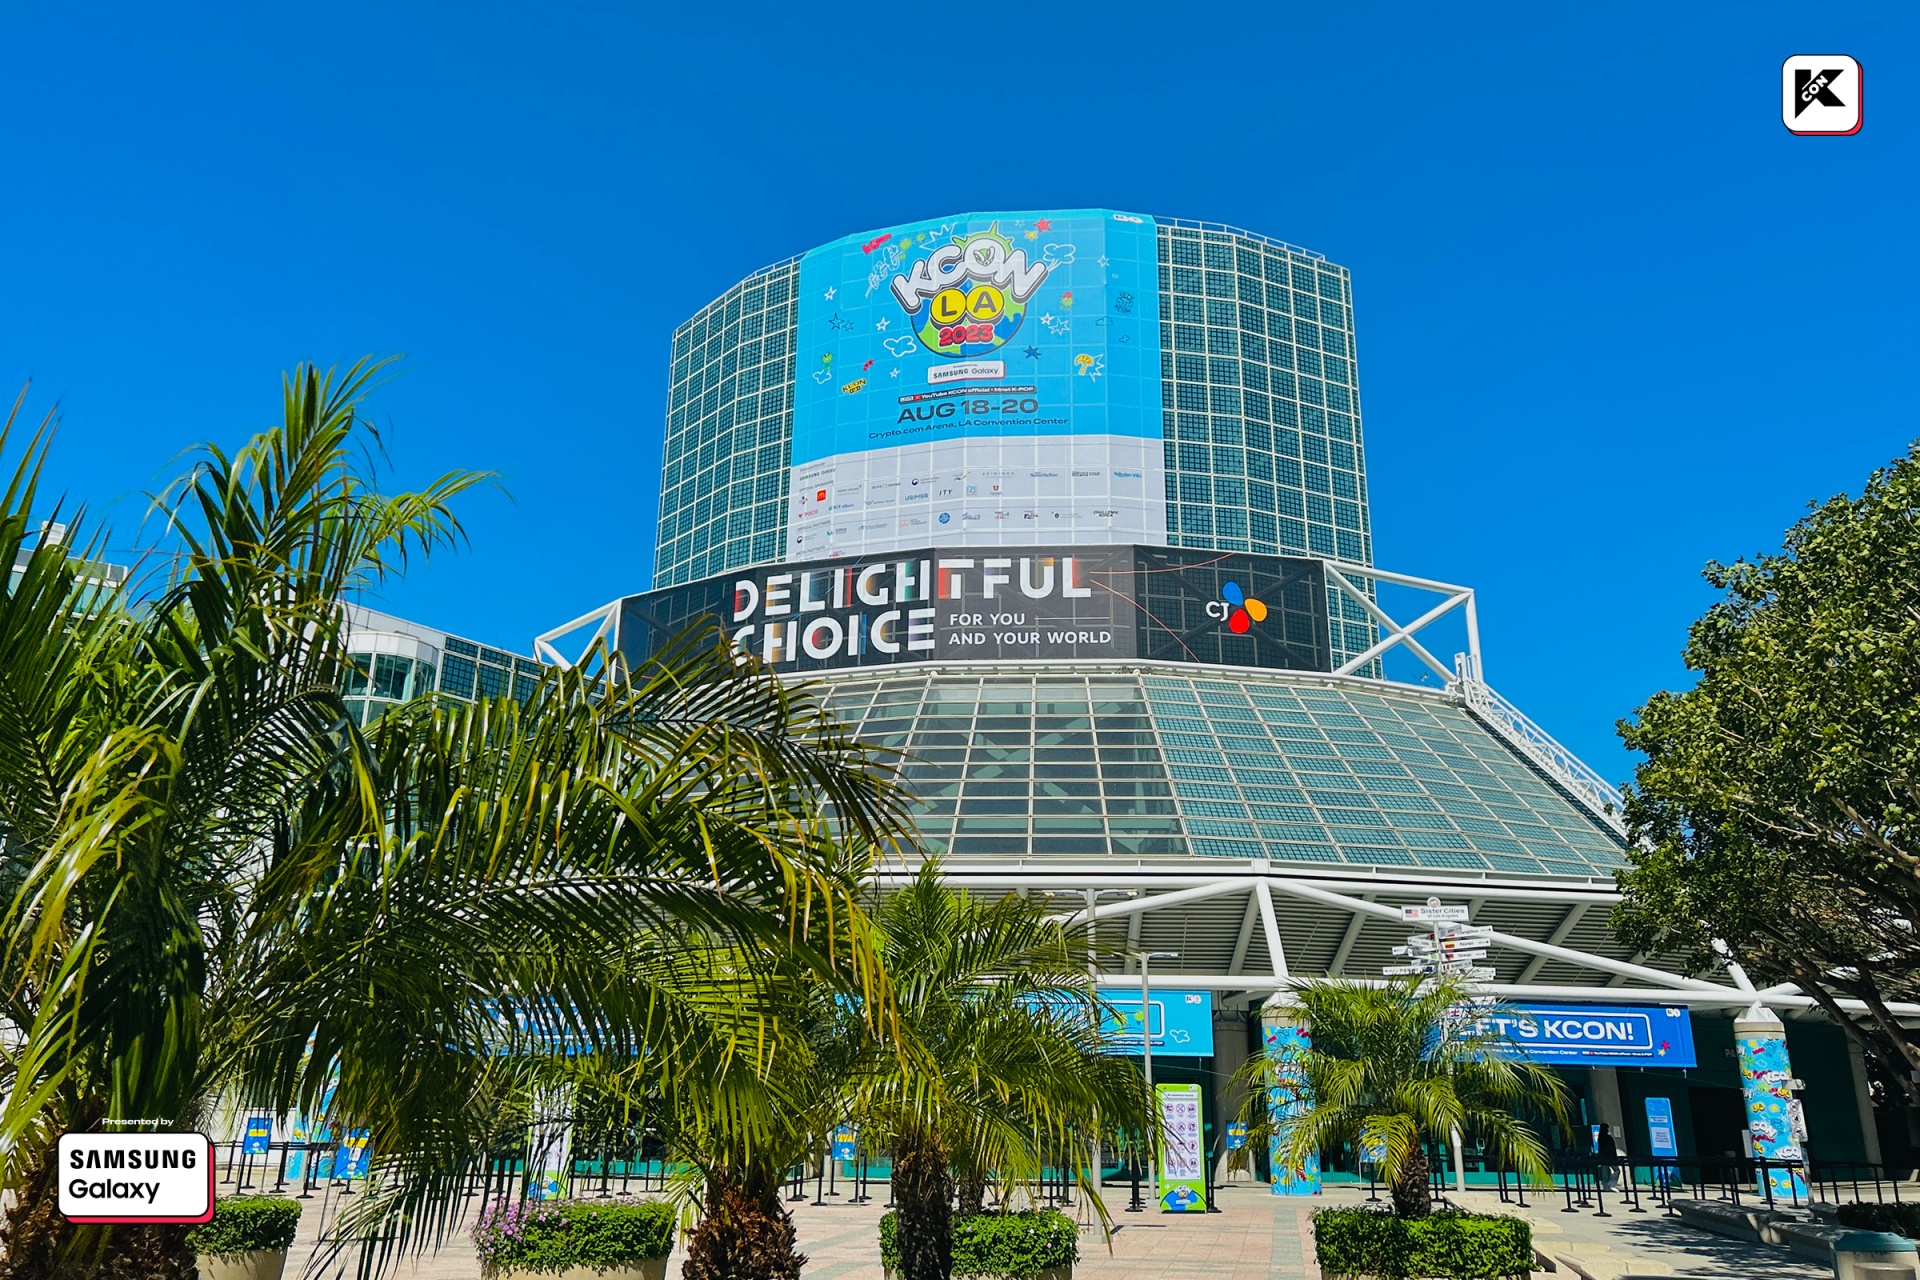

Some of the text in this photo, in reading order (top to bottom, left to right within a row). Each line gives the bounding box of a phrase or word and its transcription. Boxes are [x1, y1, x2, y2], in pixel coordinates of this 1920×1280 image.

[891, 237, 1048, 313] KCON
[938, 323, 994, 347] 2023
[933, 367, 999, 379] SAMSUNG Galaxy
[921, 391, 948, 399] YouTube
[897, 398, 1039, 424] AUG 18-20
[869, 426, 924, 439] Crypto.com
[925, 421, 957, 432] Arena,
[958, 419, 973, 427] LA
[974, 418, 1032, 426] Convention
[733, 557, 1092, 623] DELIGHTFUL
[950, 612, 1025, 626] FOR YOU
[1205, 601, 1230, 621] CJ
[730, 608, 936, 667] CHOICE
[949, 631, 1112, 645] AND YOUR WORLD
[1543, 1019, 1634, 1041] KCON!
